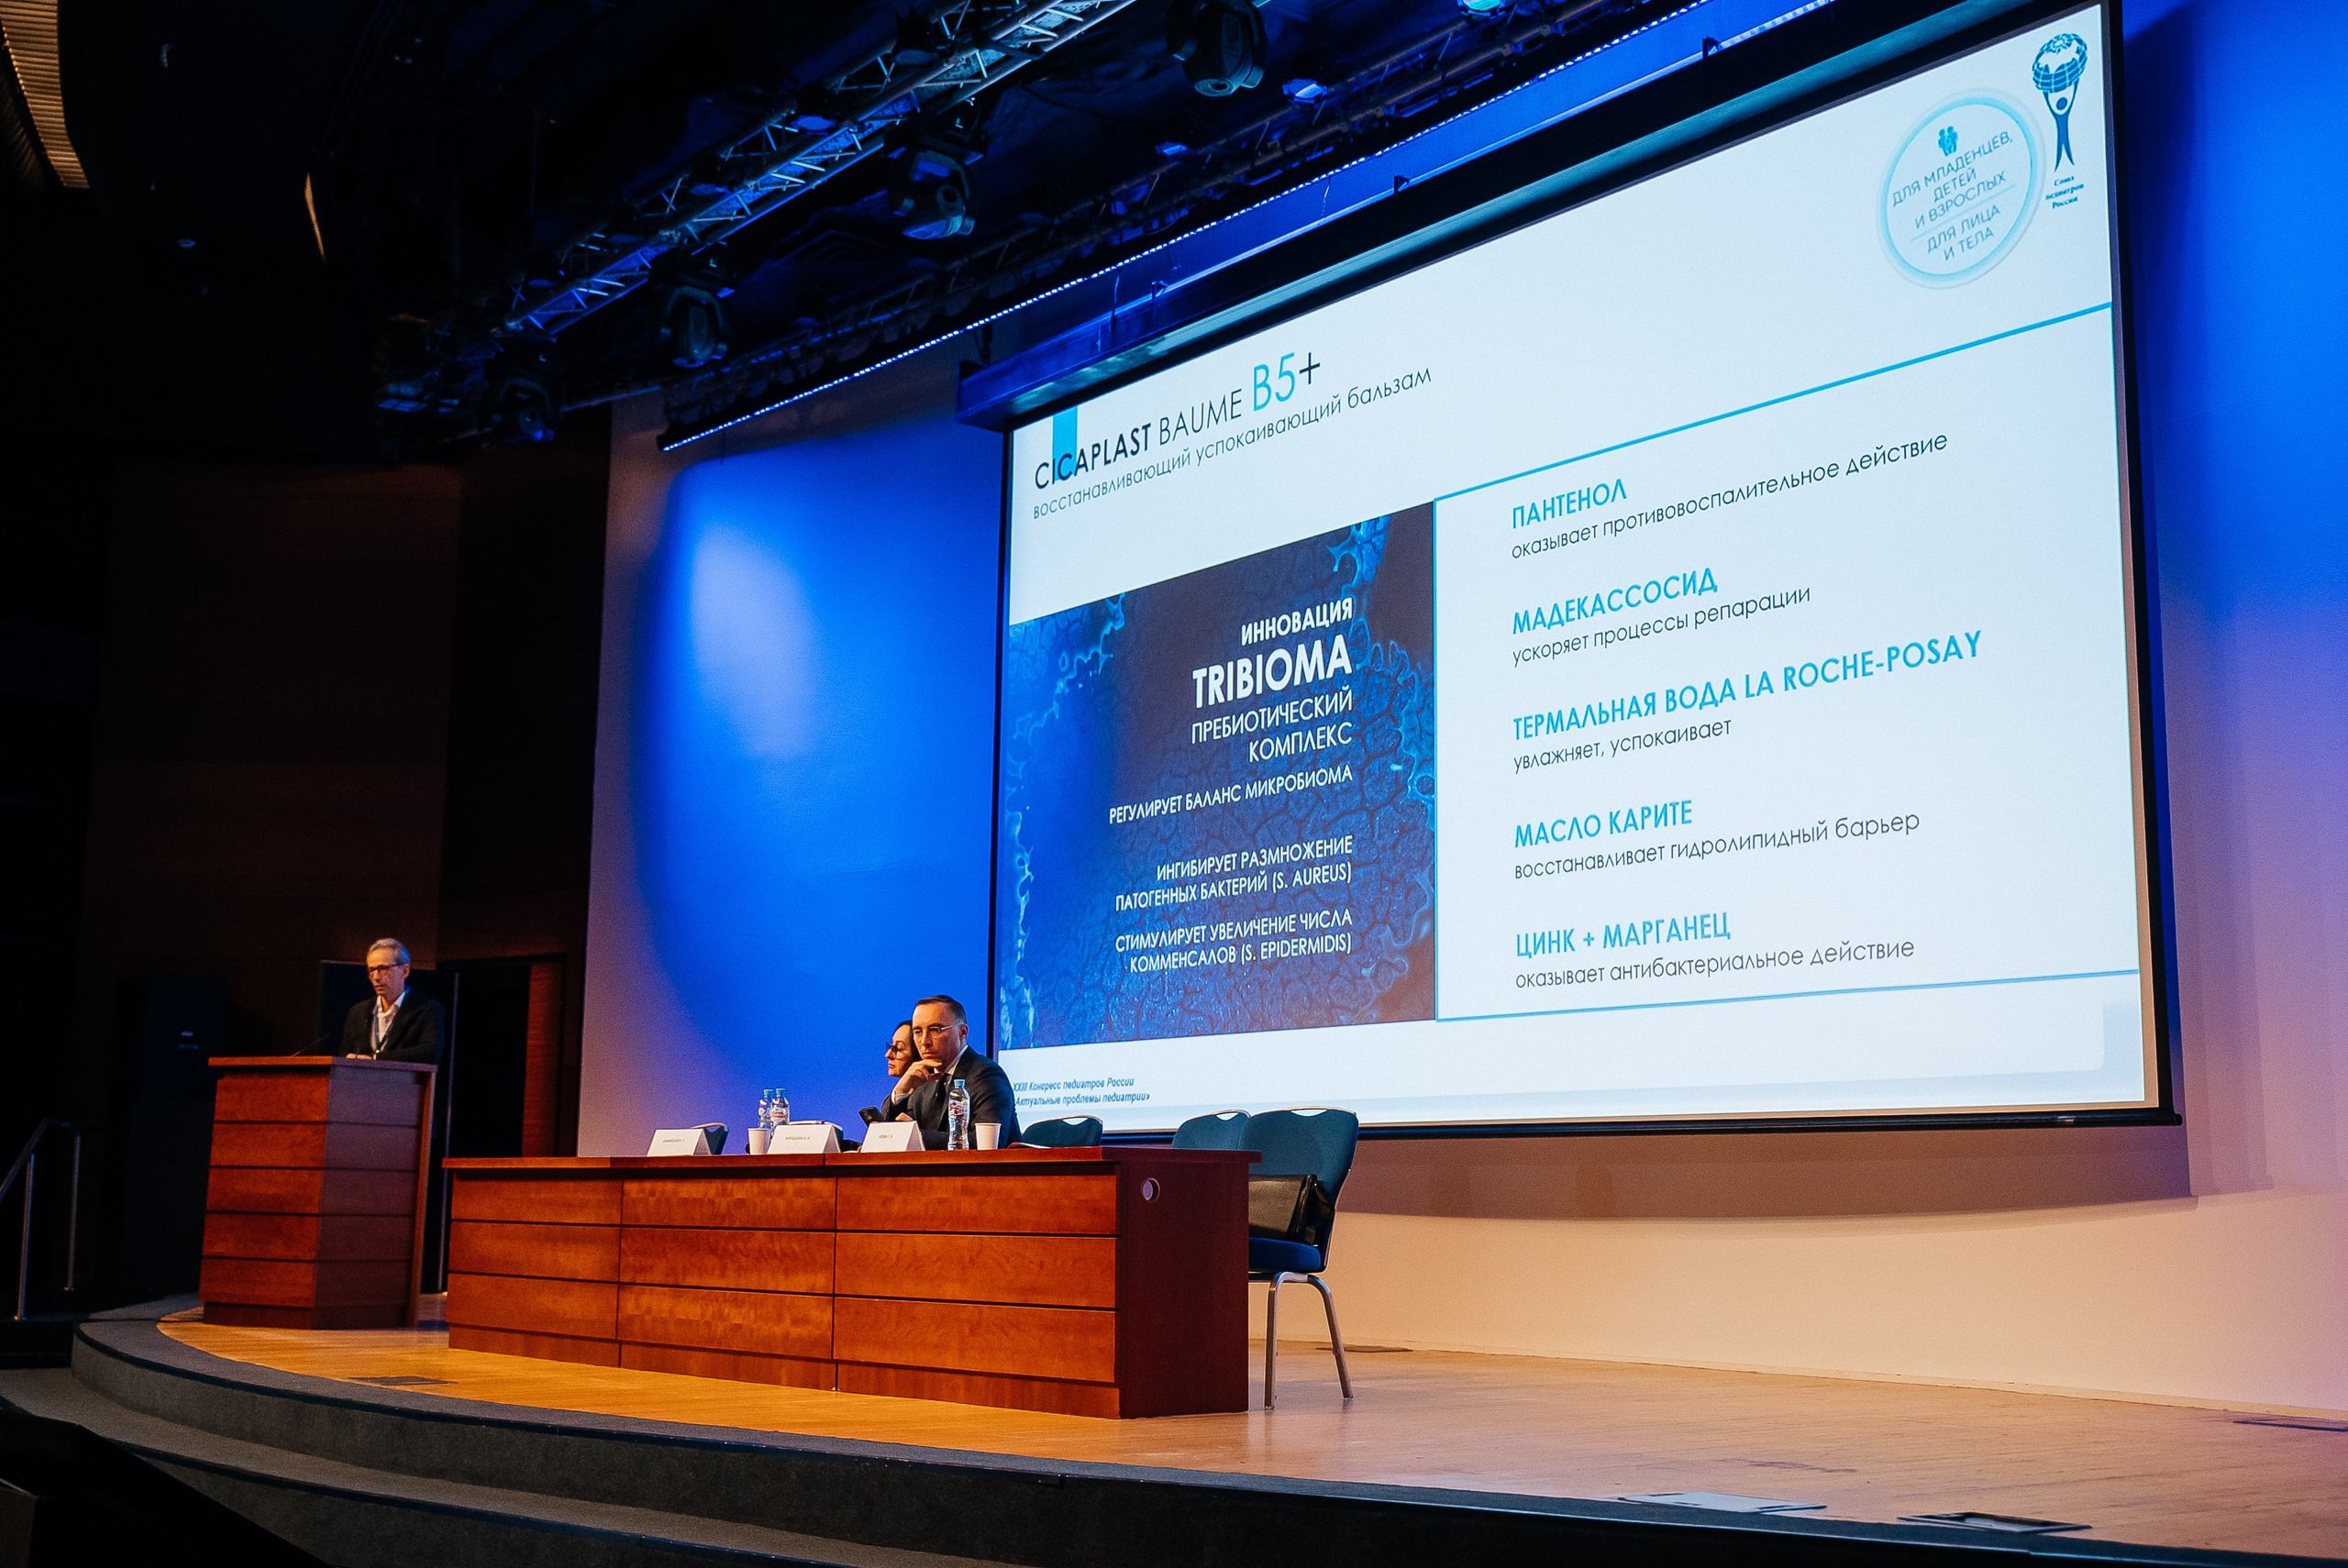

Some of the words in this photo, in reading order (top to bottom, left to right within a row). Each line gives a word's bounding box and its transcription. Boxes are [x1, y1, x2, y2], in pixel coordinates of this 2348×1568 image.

[1892, 181, 1921, 207] ДЛЯ
[1924, 131, 2013, 187] МЛАДЕНЦЕВ,
[1933, 168, 1977, 202] ДЕТЕЙ
[1915, 215, 1925, 228] И
[1928, 171, 2006, 222] ВЗРОСЛЫХ
[1927, 226, 1956, 254] ДЛЯ
[1961, 204, 2000, 234] ЛИЦА
[1944, 246, 1955, 260] И
[1958, 226, 1994, 252] ТЕЛА
[1034, 448, 1191, 519] восстанавливающий
[1196, 394, 1342, 467] успокаивающий
[1348, 368, 1431, 410] бальзам
[1035, 422, 1152, 490] CICAPLAST
[1158, 389, 1243, 447] BAUME
[1252, 351, 1321, 412] B5+
[1512, 525, 1599, 559] оказывает
[1603, 459, 1840, 536] противовоспалительное
[1845, 434, 1947, 475] действие
[1512, 479, 1627, 529] ПАНТЕНОЛ
[1241, 597, 1353, 646] ИННОВАЦИЯ
[1512, 568, 1718, 635] МАДЕКАССОСИД
[1512, 635, 1589, 668] ускоряет
[1594, 613, 1689, 648] процессы
[1695, 585, 1811, 629] репарации
[1192, 635, 1353, 709] TRIBIOMA
[1513, 692, 1656, 740] ТЕРМАЛЬНАЯ
[1666, 679, 1736, 712] ВОДА
[1744, 670, 1774, 699] LA
[1784, 630, 1981, 691] ROCHE-POSAY
[1192, 685, 1353, 744] ПРЕБИОТИЧЕСКИЙ
[1249, 722, 1352, 762] КОМПЛЕКС
[1513, 742, 1604, 774] увлажняет,
[1610, 719, 1732, 757] успокаивает
[1109, 795, 1182, 823] РЕГУЛИРУЕТ
[1186, 785, 1241, 811] БАЛАНС
[1246, 764, 1352, 800] МИКРОБИОМА
[1514, 814, 1601, 848] МАСЛО
[1610, 800, 1692, 834] КАРИТЕ
[1514, 845, 1665, 878] восстанавливает
[1670, 820, 1828, 860] гидролипидный
[1835, 812, 1920, 839] барьер
[1157, 853, 1237, 881] ИНГИБИРУЕТ
[1241, 835, 1353, 868] РАЗМНОЖЕНИЕ
[1115, 887, 1197, 911] ПАТОГЕННЫХ
[1201, 871, 1268, 900] БАКТЕРИЙ
[1272, 872, 1289, 894] (S.
[1292, 862, 1352, 887] AUREUS)
[1114, 924, 1206, 953] СТИМУЛИРУЕТ
[1210, 914, 1296, 943] УВЕЛИЧЕНИЕ
[1300, 908, 1352, 929] ЧИСЛА
[1130, 946, 1236, 973] КОММЕНСАЛОВ
[1241, 944, 1257, 965] (S.
[1260, 933, 1352, 960] EPIDERMIDIS)
[1516, 929, 1576, 959] ЦИНК
[1582, 933, 1595, 947] +
[1603, 912, 1731, 949] МАРГАНЕЦ
[1515, 966, 1604, 988] оказывает
[1610, 948, 1803, 984] антибактериальное
[1811, 939, 1914, 966] действие
[1029, 1082, 1061, 1092] Конгресс
[1063, 1078, 1104, 1091] педиатров
[1107, 1077, 1135, 1088] России
[1062, 1093, 1101, 1106] проблемы
[1102, 1092, 1150, 1104] педиатрии»
